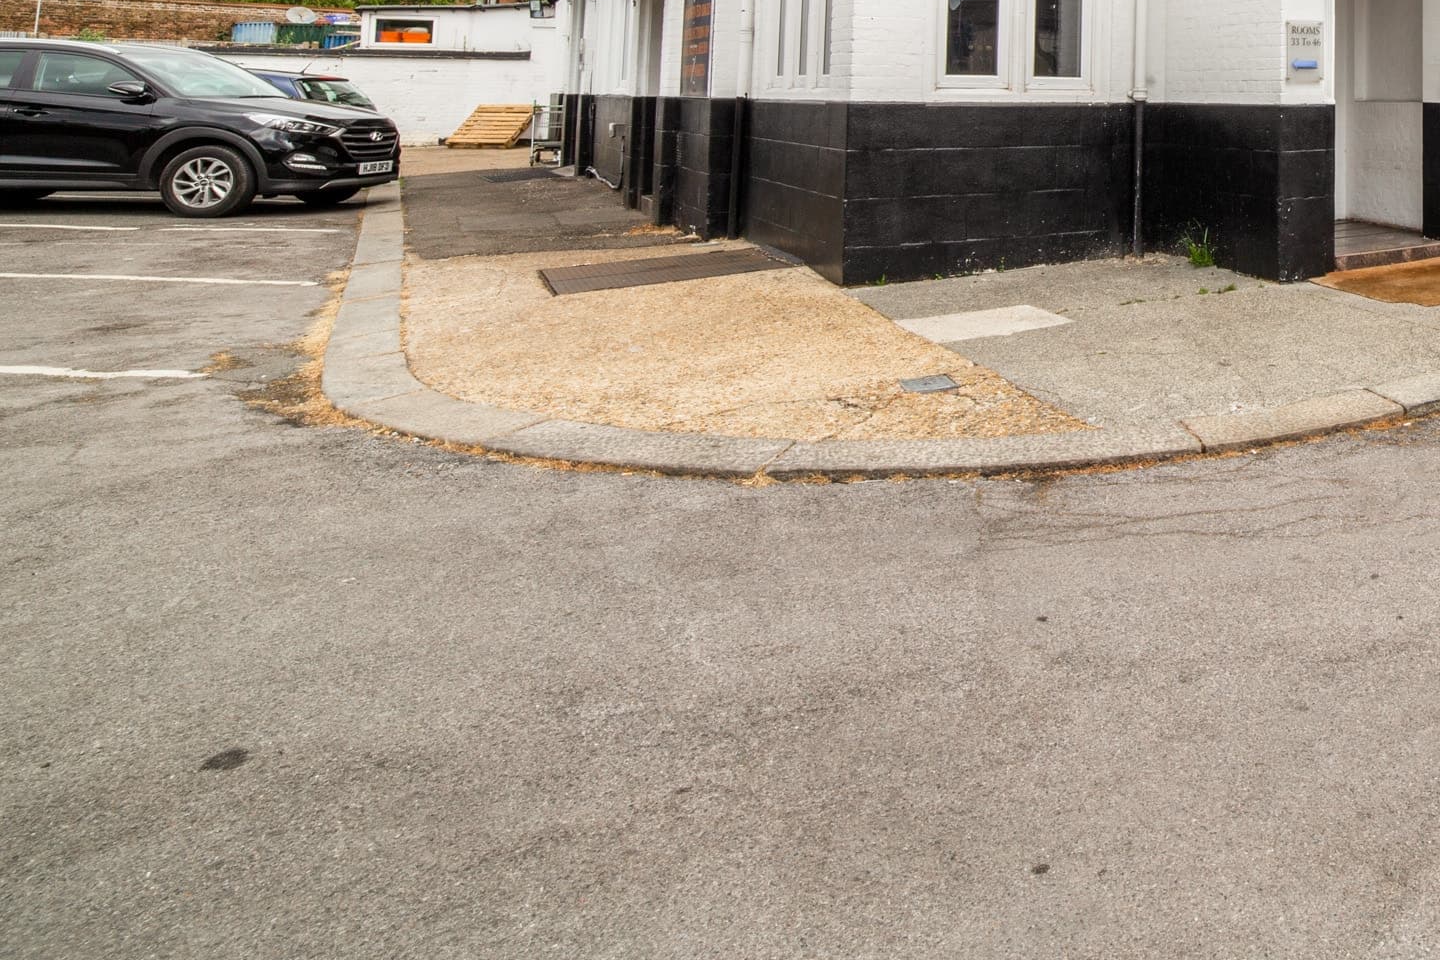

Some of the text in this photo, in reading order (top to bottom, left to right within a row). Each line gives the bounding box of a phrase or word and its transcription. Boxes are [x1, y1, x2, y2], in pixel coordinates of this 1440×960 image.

[1291, 25, 1321, 35] ROOMS
[1291, 38, 1300, 46] 33
[1312, 38, 1321, 47] 46
